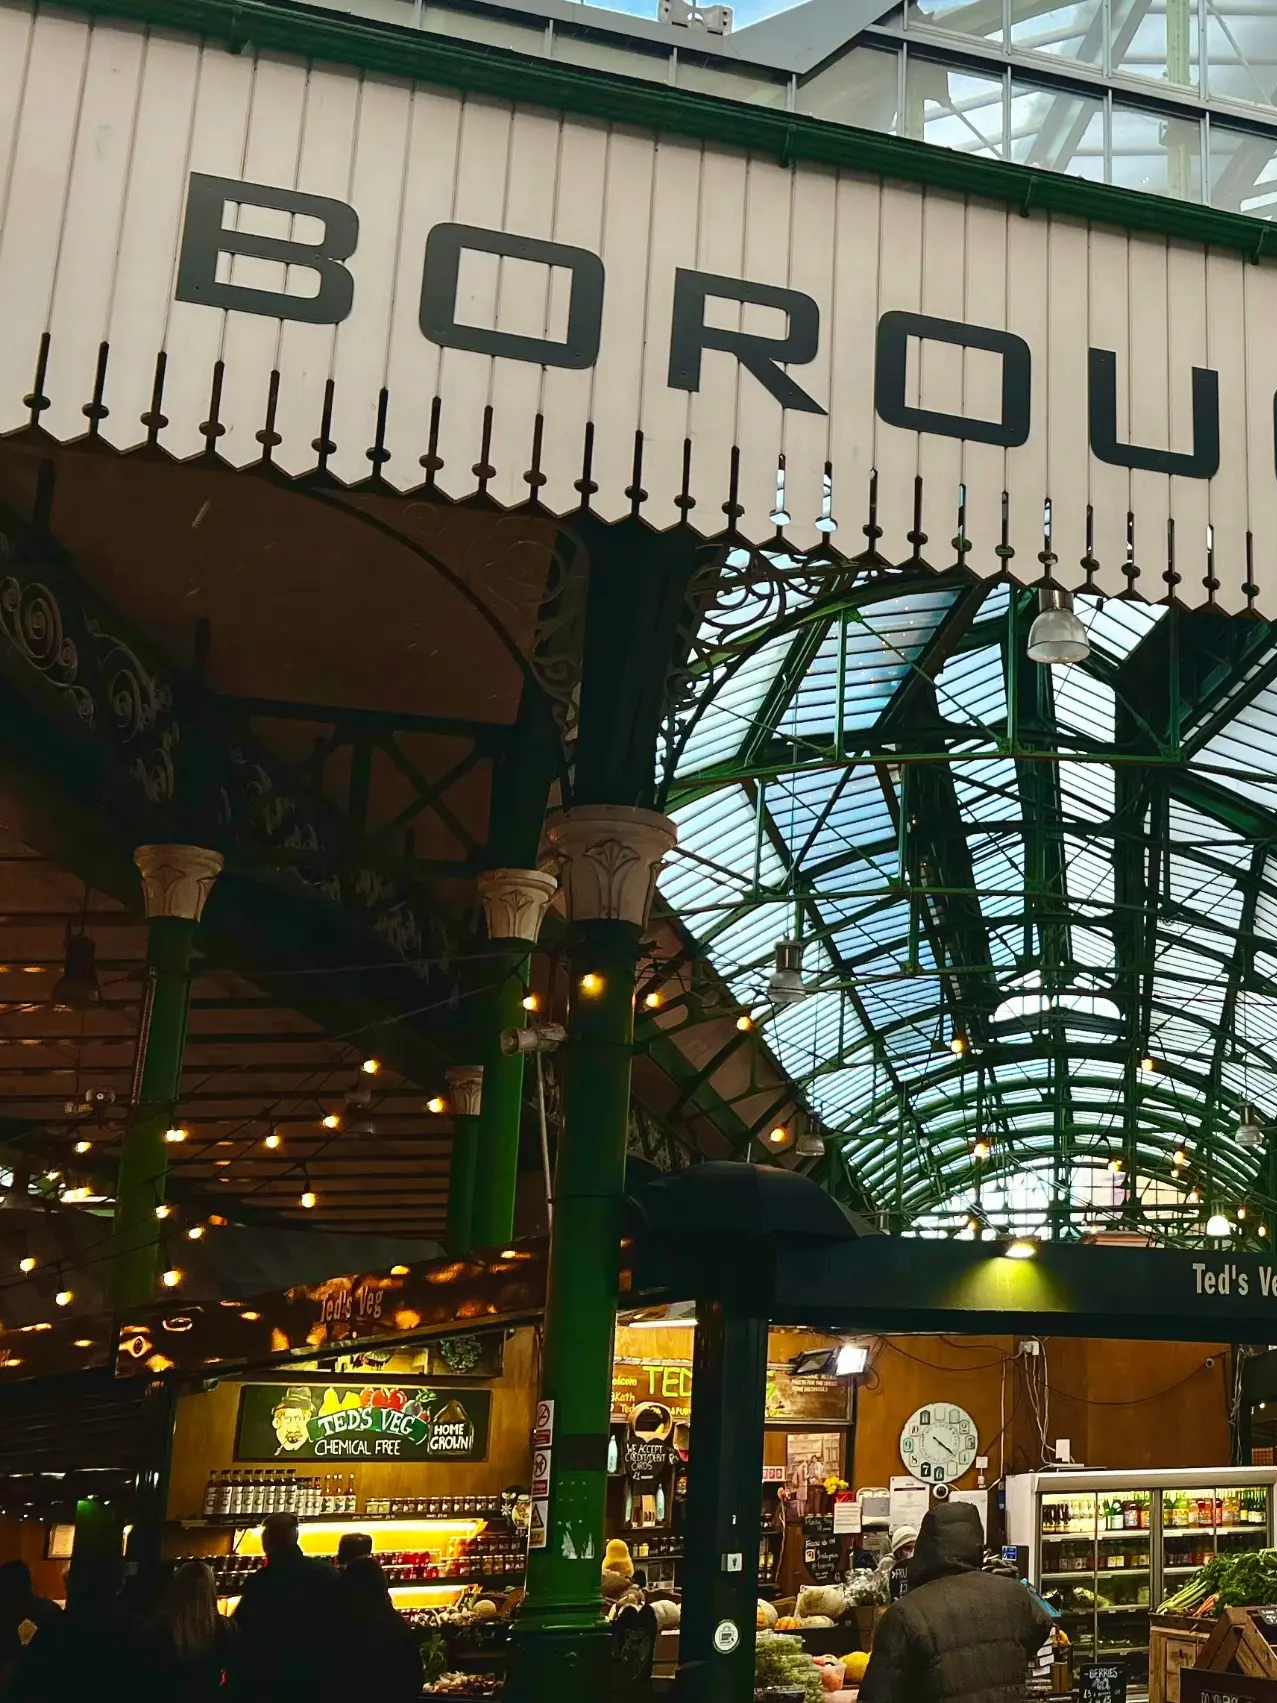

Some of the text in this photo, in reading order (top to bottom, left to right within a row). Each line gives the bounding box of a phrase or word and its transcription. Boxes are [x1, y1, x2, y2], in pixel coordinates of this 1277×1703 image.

[1192, 1262, 1249, 1296] Ted's
[359, 1285, 384, 1319] Veg
[318, 1407, 415, 1437] TED'S VEG
[434, 1422, 464, 1436] HOME
[314, 1439, 401, 1456] CHEMICAL FREE
[430, 1435, 469, 1451] GROWN
[638, 1444, 664, 1454] ACCEPT
[631, 1461, 653, 1472] CARDS
[922, 1464, 929, 1476] 7
